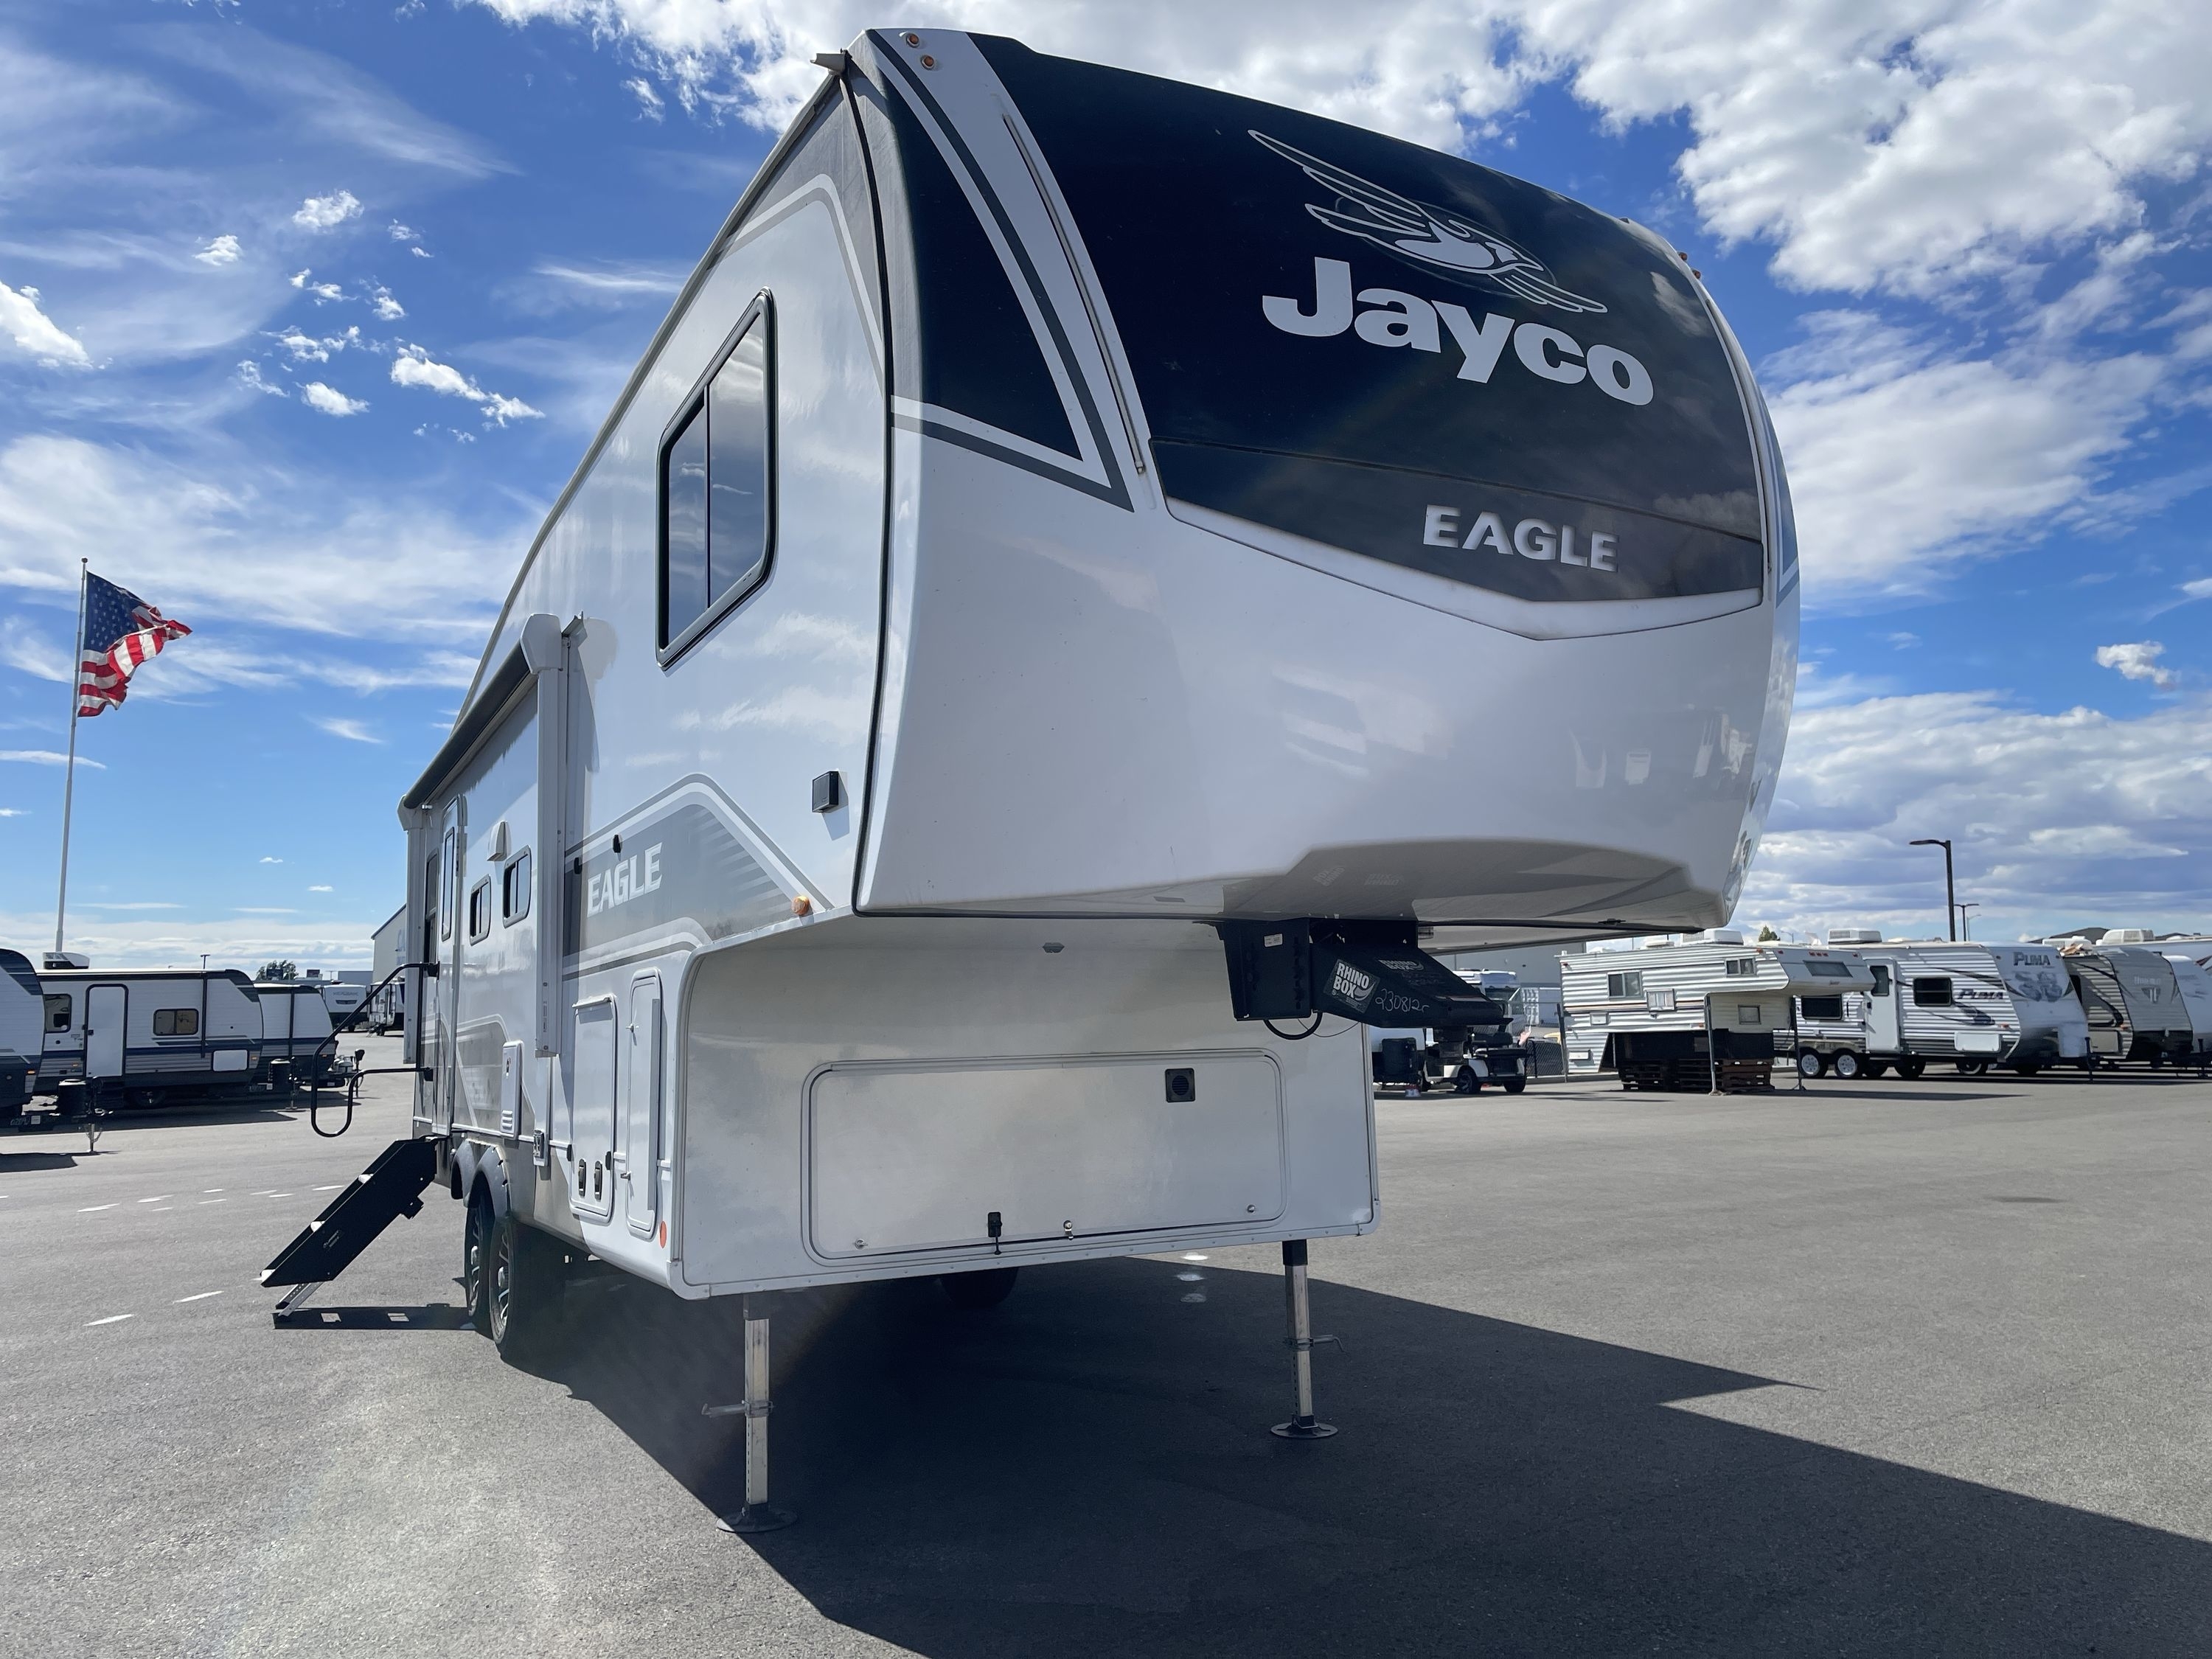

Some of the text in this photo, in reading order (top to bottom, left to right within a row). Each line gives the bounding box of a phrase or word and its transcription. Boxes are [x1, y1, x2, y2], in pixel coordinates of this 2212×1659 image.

[1262, 256, 1654, 406] Jayco
[1422, 504, 1620, 573] EAGLE
[587, 842, 662, 918] EAGLE
[2013, 951, 2051, 966] PUMA
[1333, 975, 1357, 998] BOX
[1336, 962, 1370, 990] RHINO
[1957, 989, 2003, 1000] PUMA
